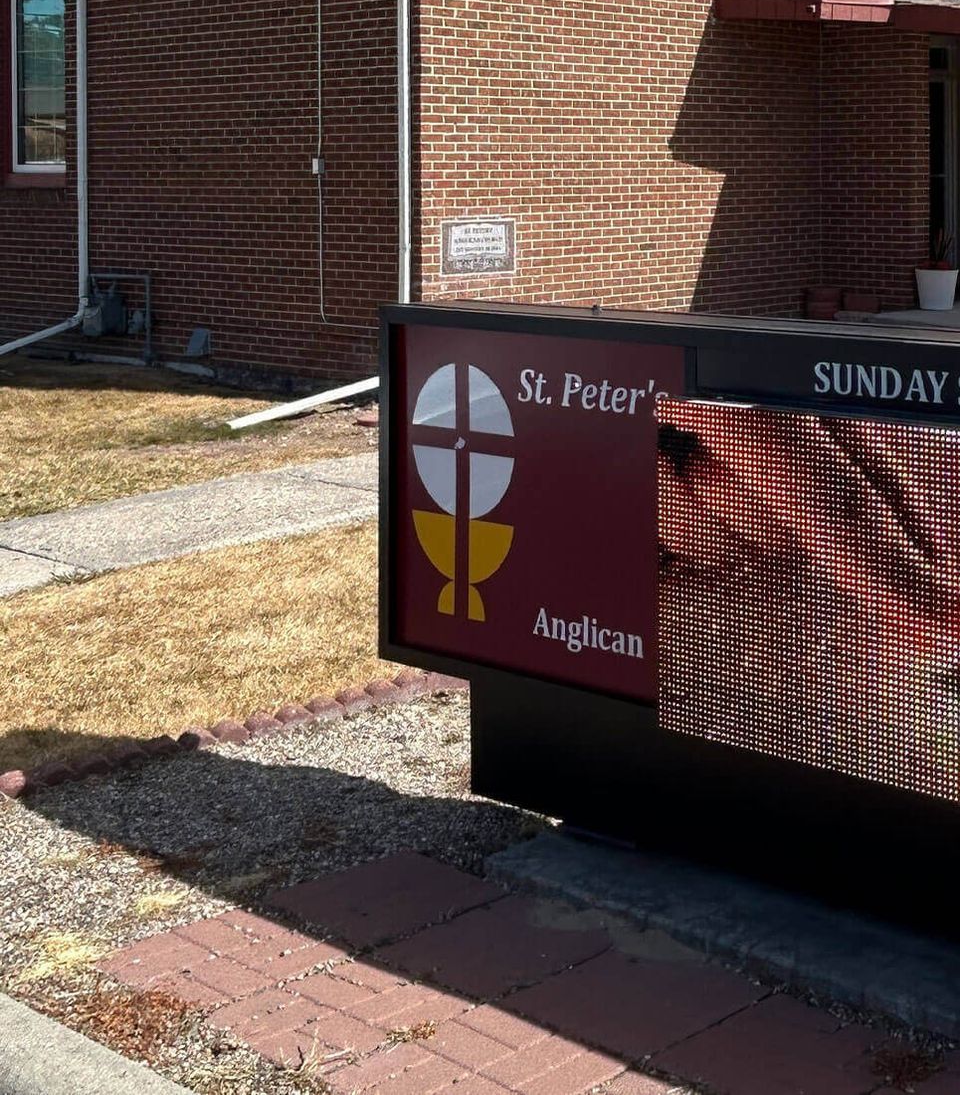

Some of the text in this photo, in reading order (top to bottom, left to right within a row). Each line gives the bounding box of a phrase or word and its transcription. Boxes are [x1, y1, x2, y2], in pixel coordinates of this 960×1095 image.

[518, 368, 552, 405] St.
[814, 361, 949, 404] SUNDAY
[532, 607, 644, 659] Anglican
